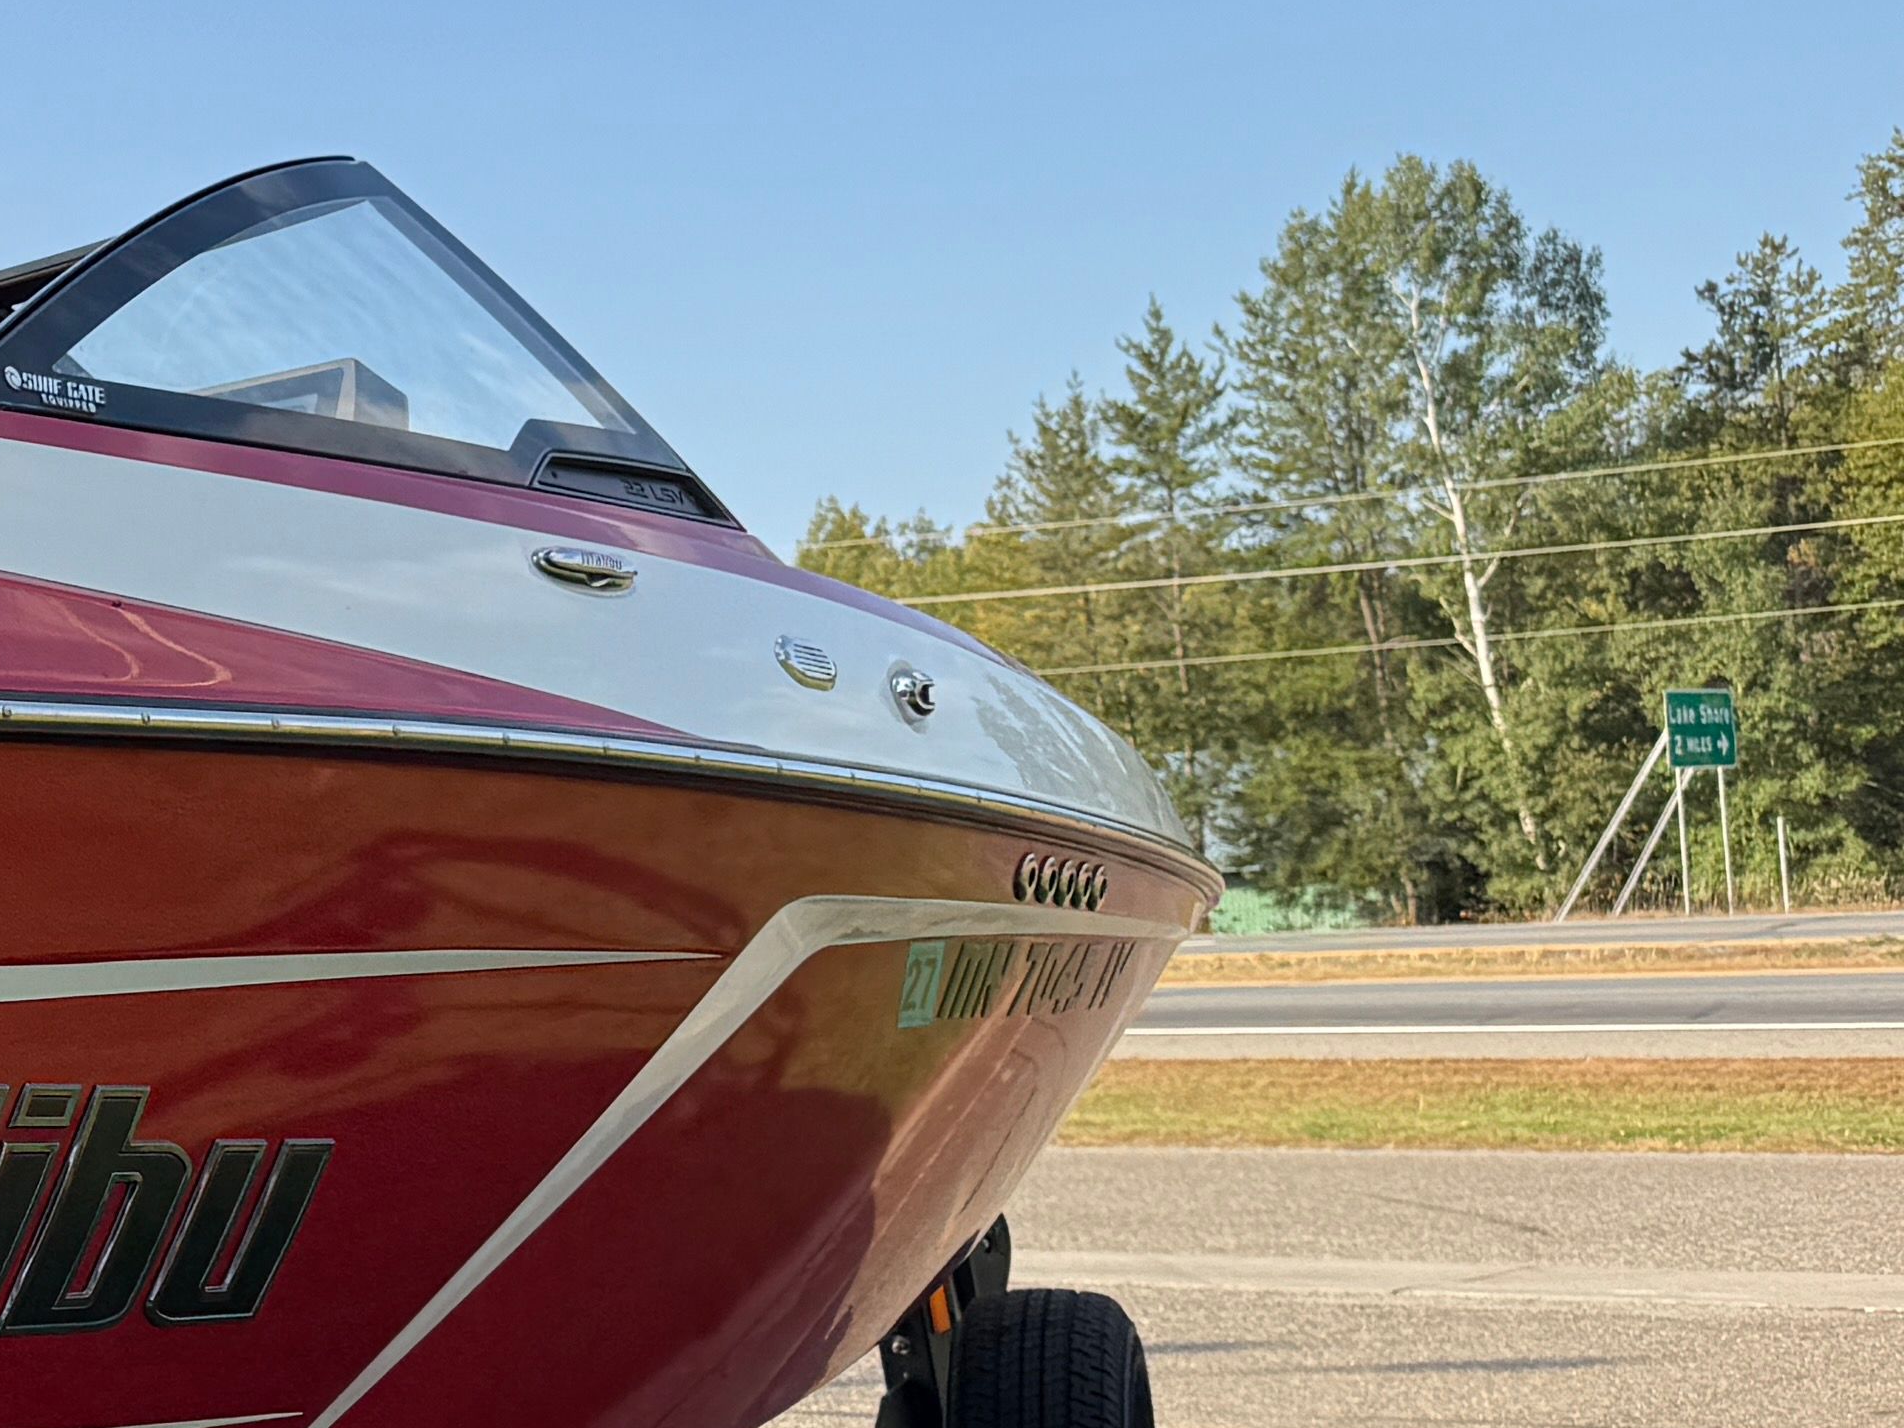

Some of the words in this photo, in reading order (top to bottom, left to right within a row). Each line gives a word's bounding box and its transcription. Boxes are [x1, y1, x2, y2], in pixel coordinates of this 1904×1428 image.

[66, 381, 108, 406] GATE
[1668, 703, 1696, 725] Lake
[1673, 734, 1684, 756] 2
